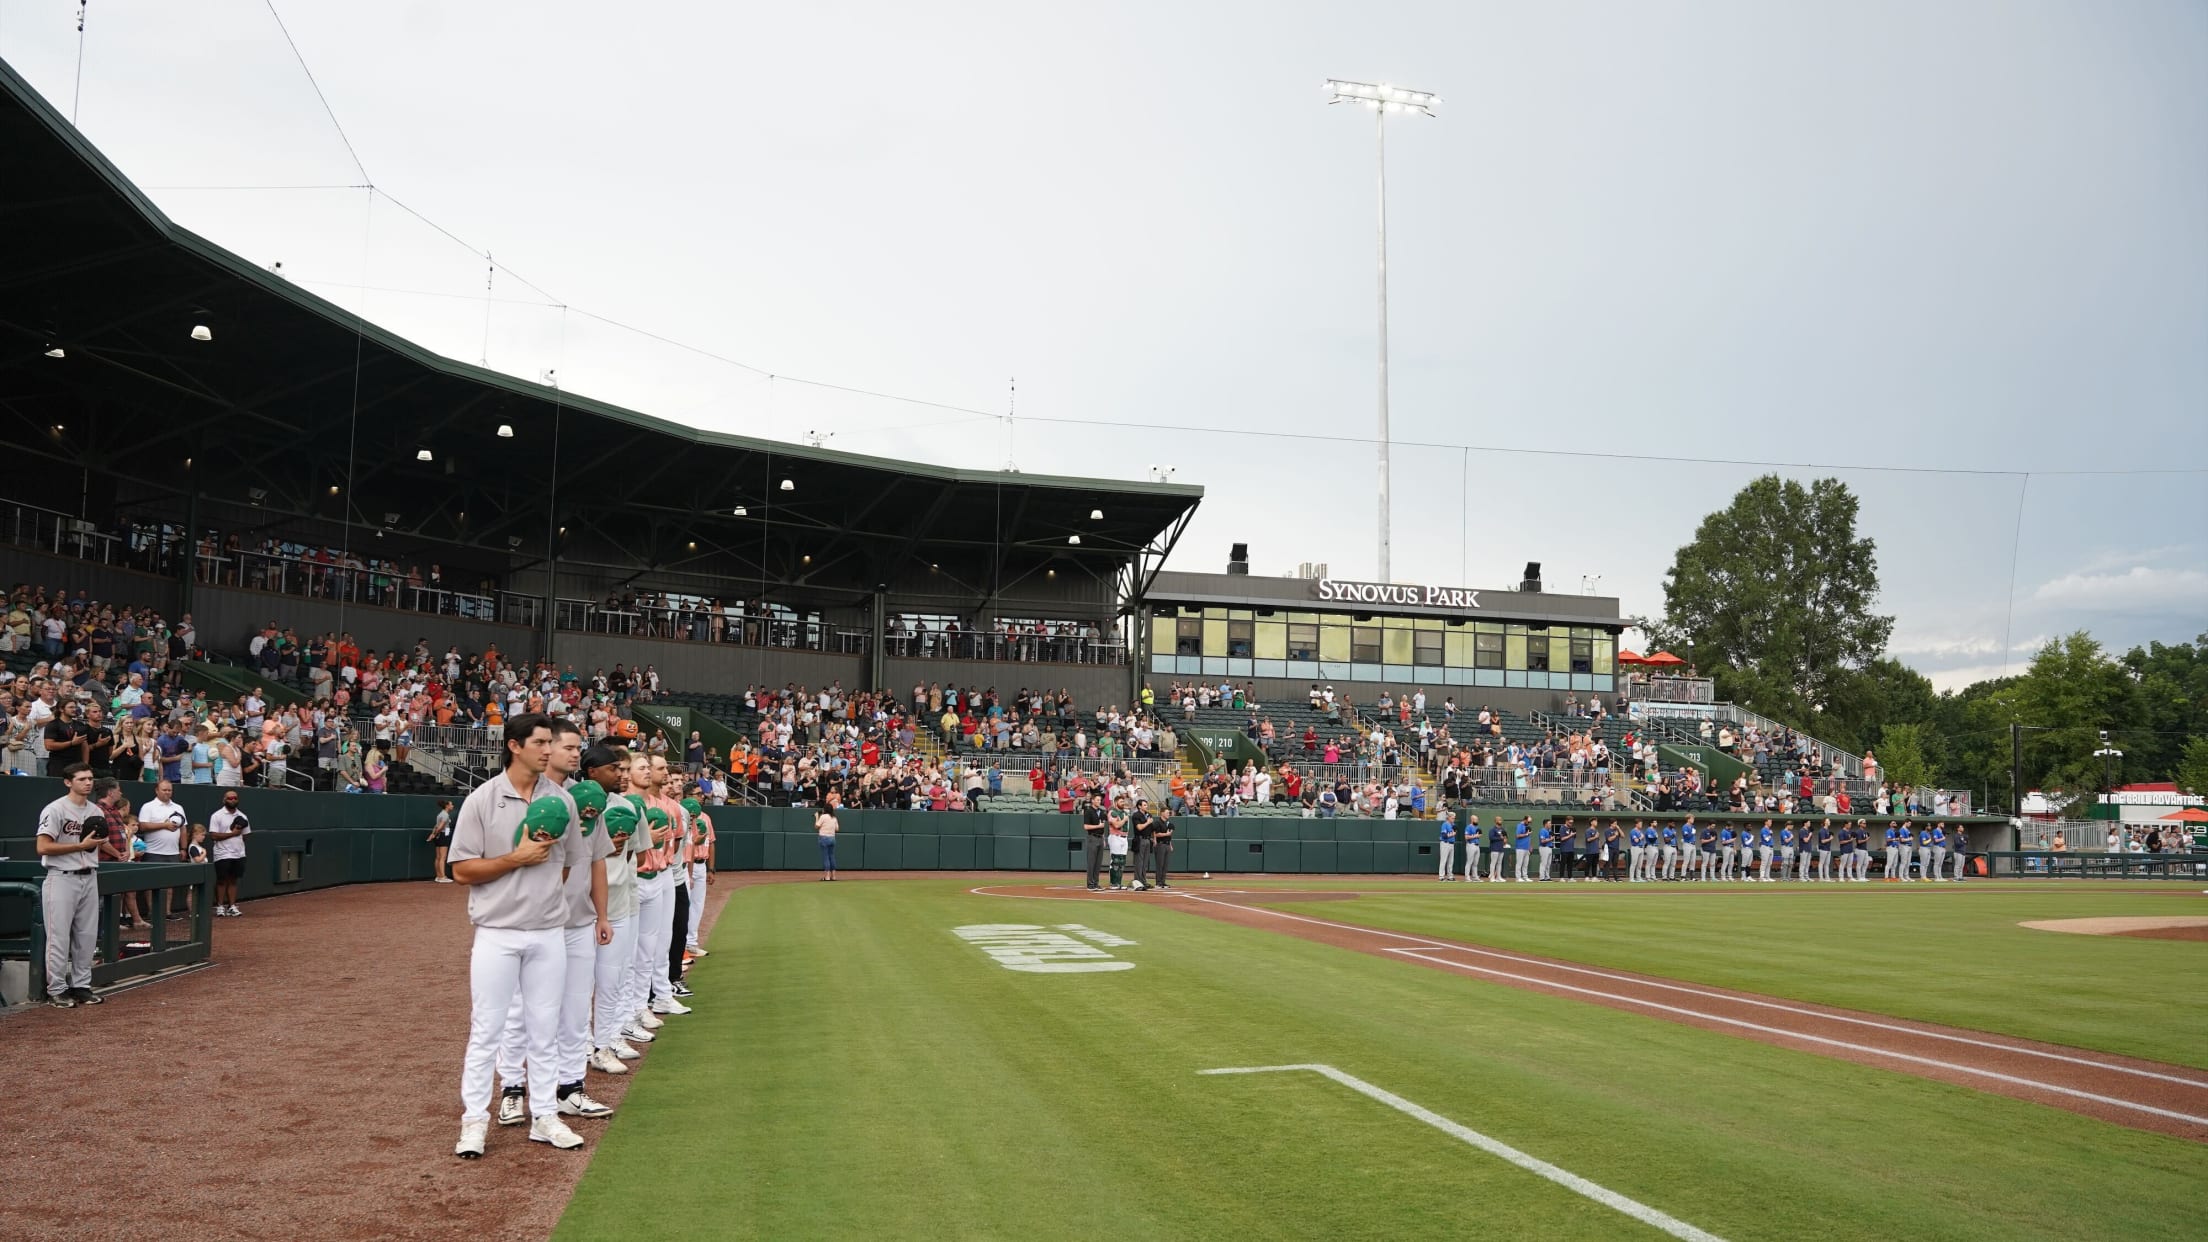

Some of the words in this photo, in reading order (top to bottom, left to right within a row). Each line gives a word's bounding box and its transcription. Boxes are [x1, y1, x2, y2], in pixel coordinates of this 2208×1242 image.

[1319, 578, 1419, 604] SYNOVUS
[1424, 584, 1480, 608] PARK
[666, 716, 682, 727] 208
[1218, 738, 1233, 748] 210
[2152, 794, 2205, 806] ADVANTAGE
